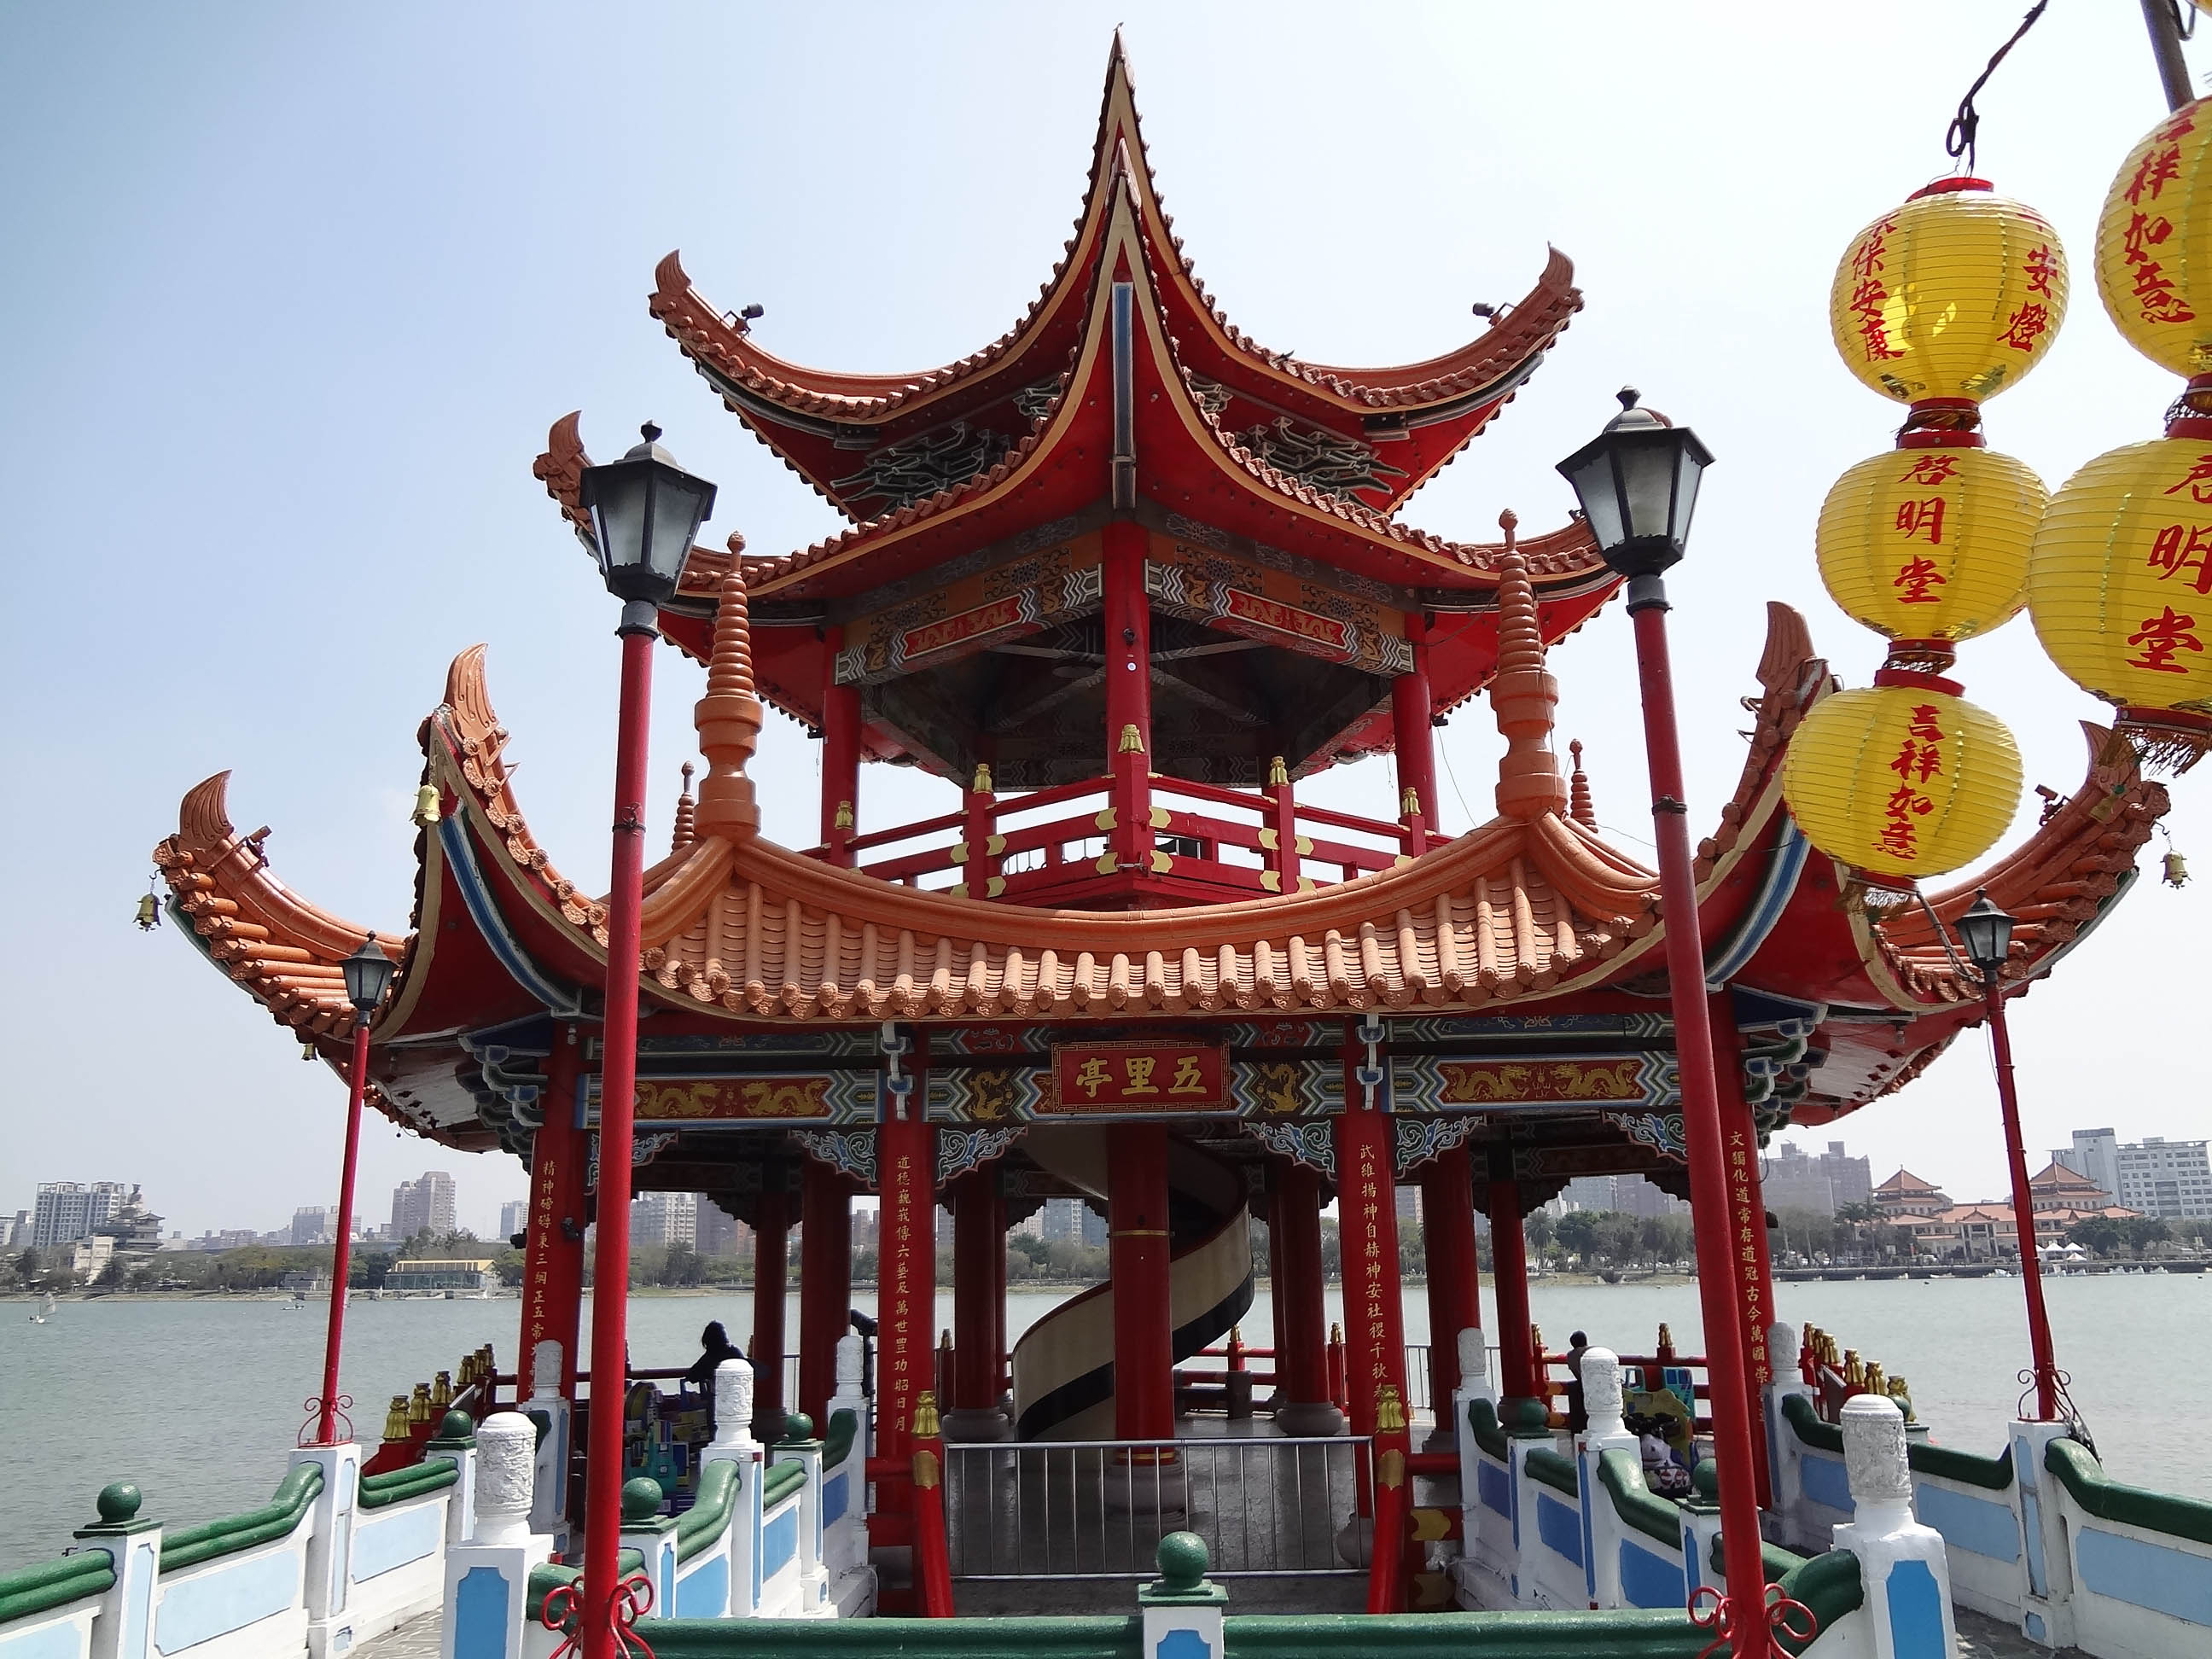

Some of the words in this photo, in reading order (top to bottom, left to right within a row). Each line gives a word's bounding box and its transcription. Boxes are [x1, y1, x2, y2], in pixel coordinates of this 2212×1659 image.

[2124, 99, 2196, 323] 吉祥如意
[1871, 703, 1946, 860] 吉祥如意
[1359, 1144, 1389, 1413] 武維揚神自赫神安社稷千秋
[1729, 1131, 1769, 1422] 文獨化道常存道冠古今萬國崇
